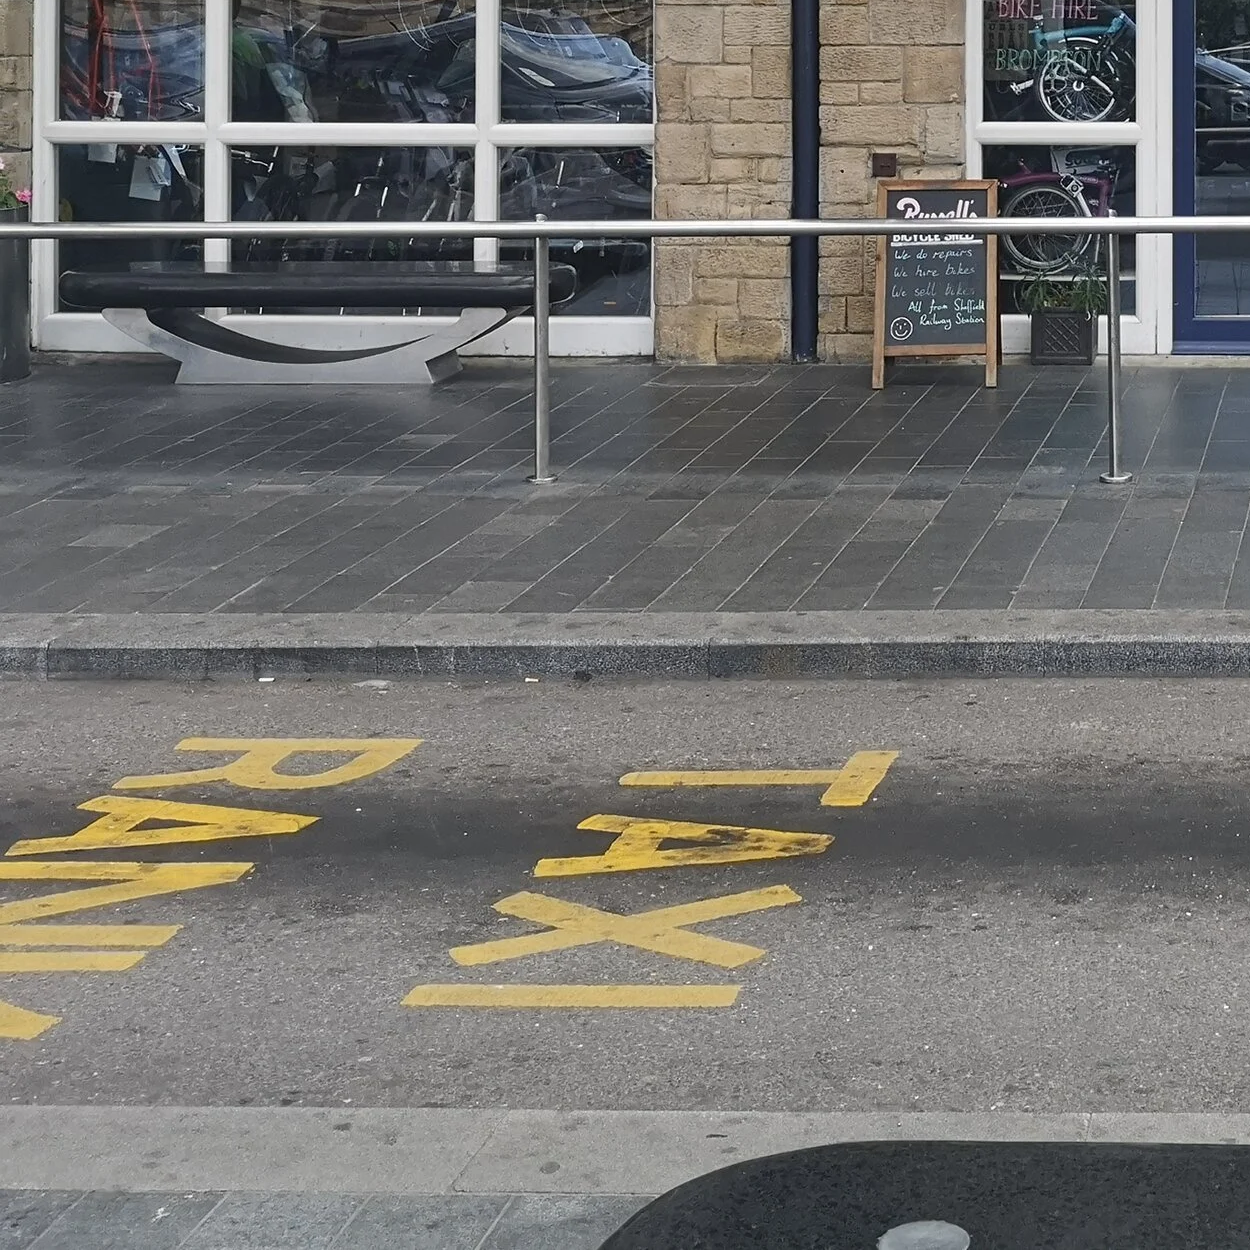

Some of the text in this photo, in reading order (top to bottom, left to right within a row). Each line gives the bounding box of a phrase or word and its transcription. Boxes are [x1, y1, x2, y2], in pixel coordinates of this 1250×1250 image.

[995, 48, 1101, 71] BROMPTON
[894, 249, 972, 262] We do repairs
[893, 262, 976, 278] We hire bikes
[891, 285, 907, 298] We
[914, 282, 936, 296] sell
[908, 298, 985, 314] All from Sheffield
[919, 312, 985, 330] Railway Station
[400, 750, 901, 1008] TAXI
